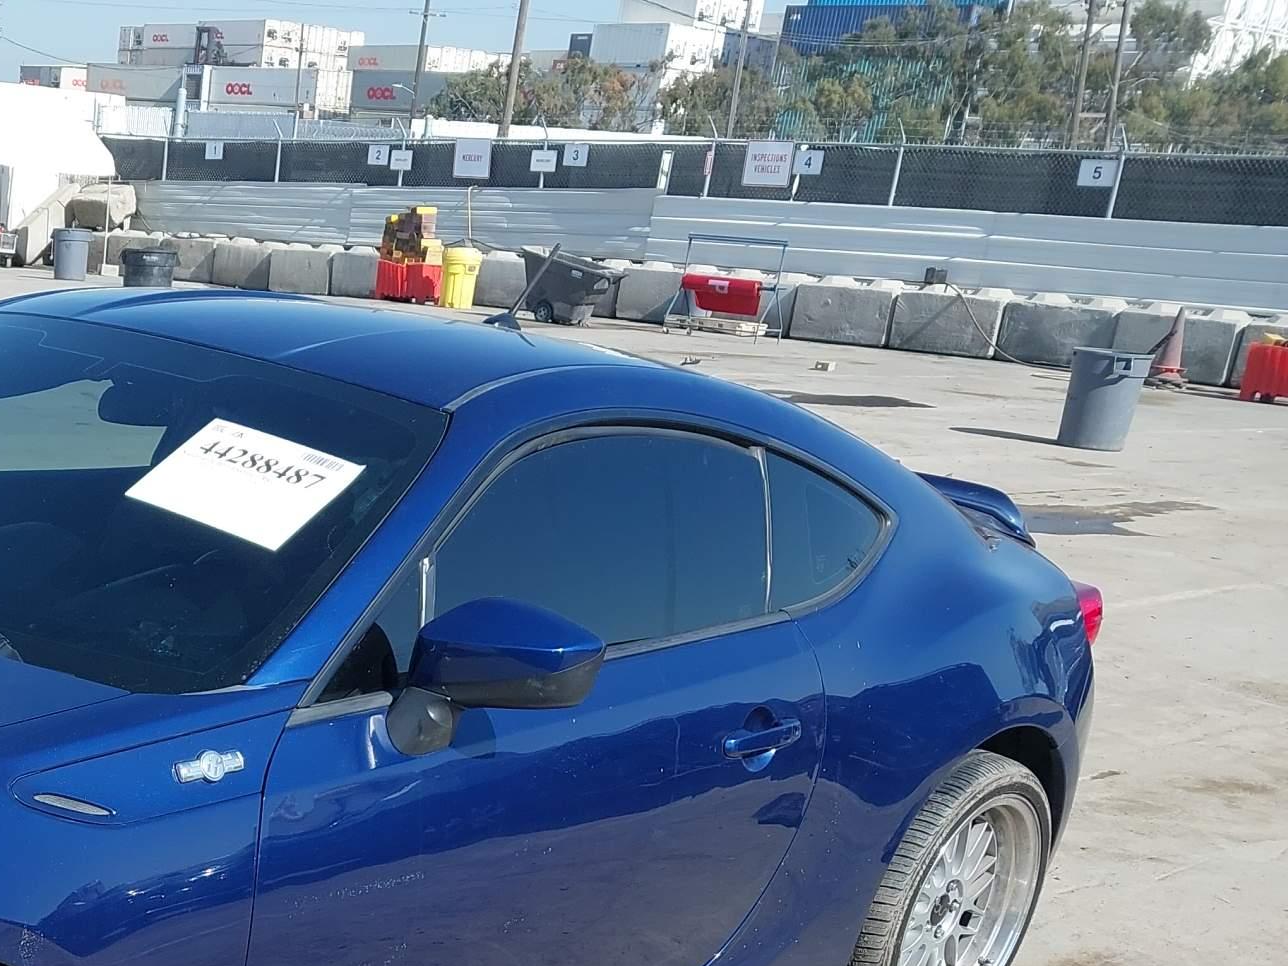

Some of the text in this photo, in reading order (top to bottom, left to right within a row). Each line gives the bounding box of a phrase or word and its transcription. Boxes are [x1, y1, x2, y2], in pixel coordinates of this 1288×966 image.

[225, 83, 253, 95] OOCL
[367, 87, 396, 100] OOCL
[375, 150, 382, 160] 2
[572, 150, 580, 161] 3
[804, 156, 813, 169] 4
[1092, 166, 1103, 180] 5
[199, 440, 326, 489] 44288487
